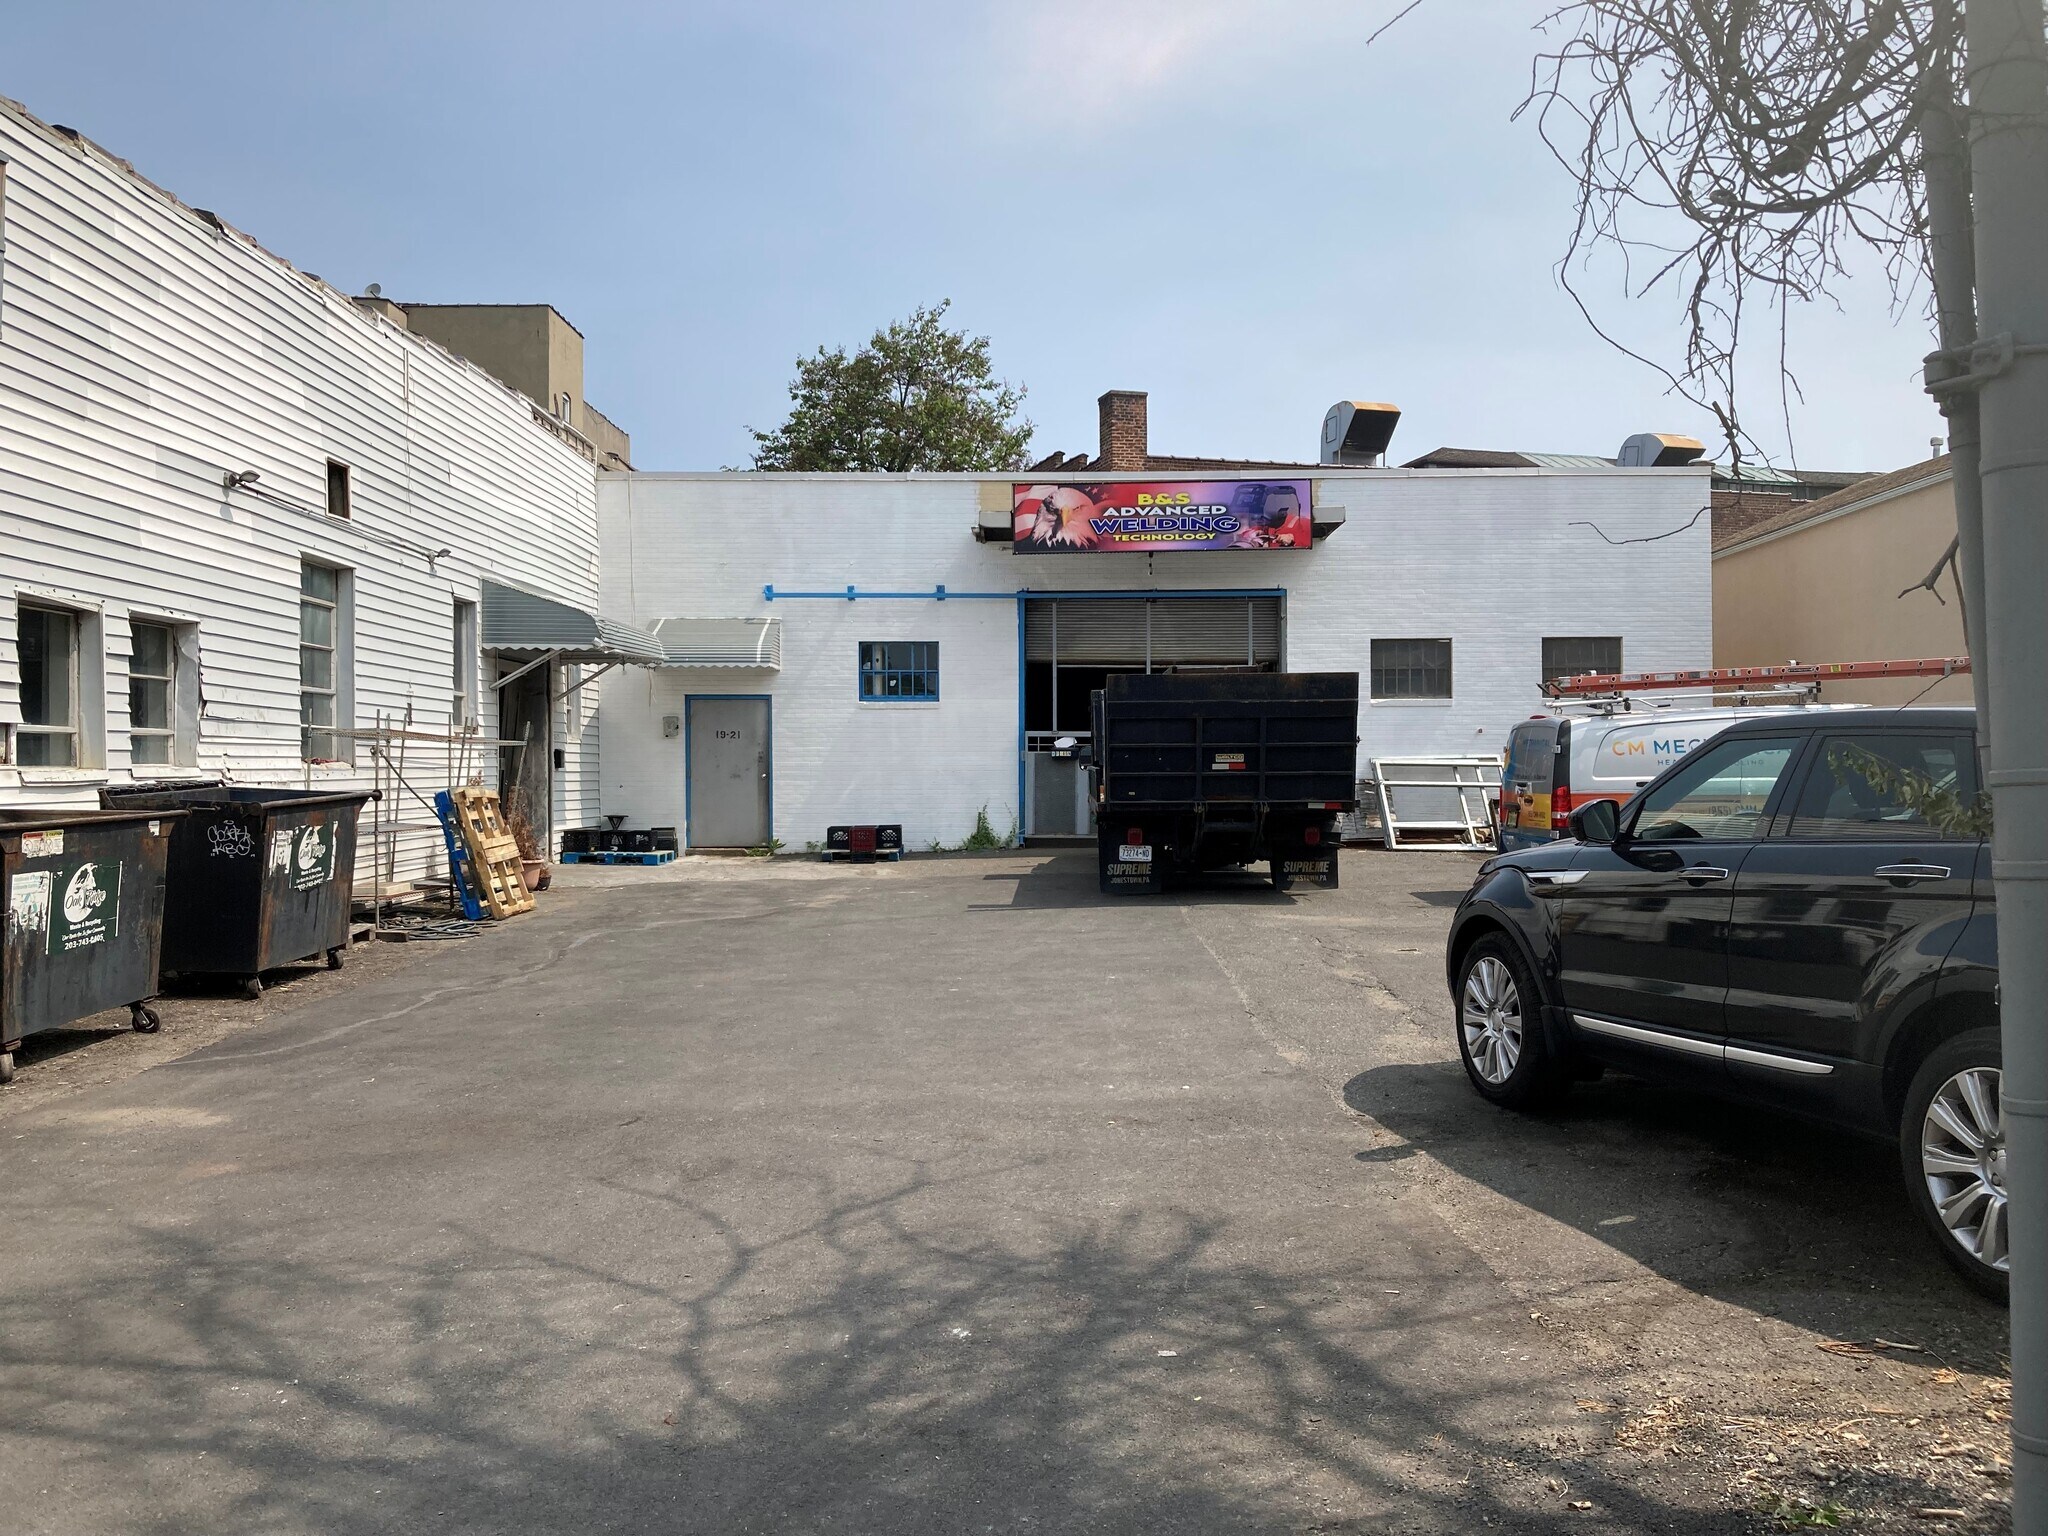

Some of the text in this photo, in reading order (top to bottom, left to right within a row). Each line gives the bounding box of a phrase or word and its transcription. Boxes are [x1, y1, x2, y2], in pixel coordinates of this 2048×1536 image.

[1137, 493, 1191, 505] B&S
[1103, 505, 1227, 517] ADVANCED
[1090, 516, 1240, 535] WELDING
[1113, 533, 1216, 541] TECHNOLOGY
[716, 730, 741, 739] 19-21
[1612, 740, 1645, 756] CM
[1107, 863, 1152, 875] SUPREME
[1283, 861, 1330, 872] SUPREME
